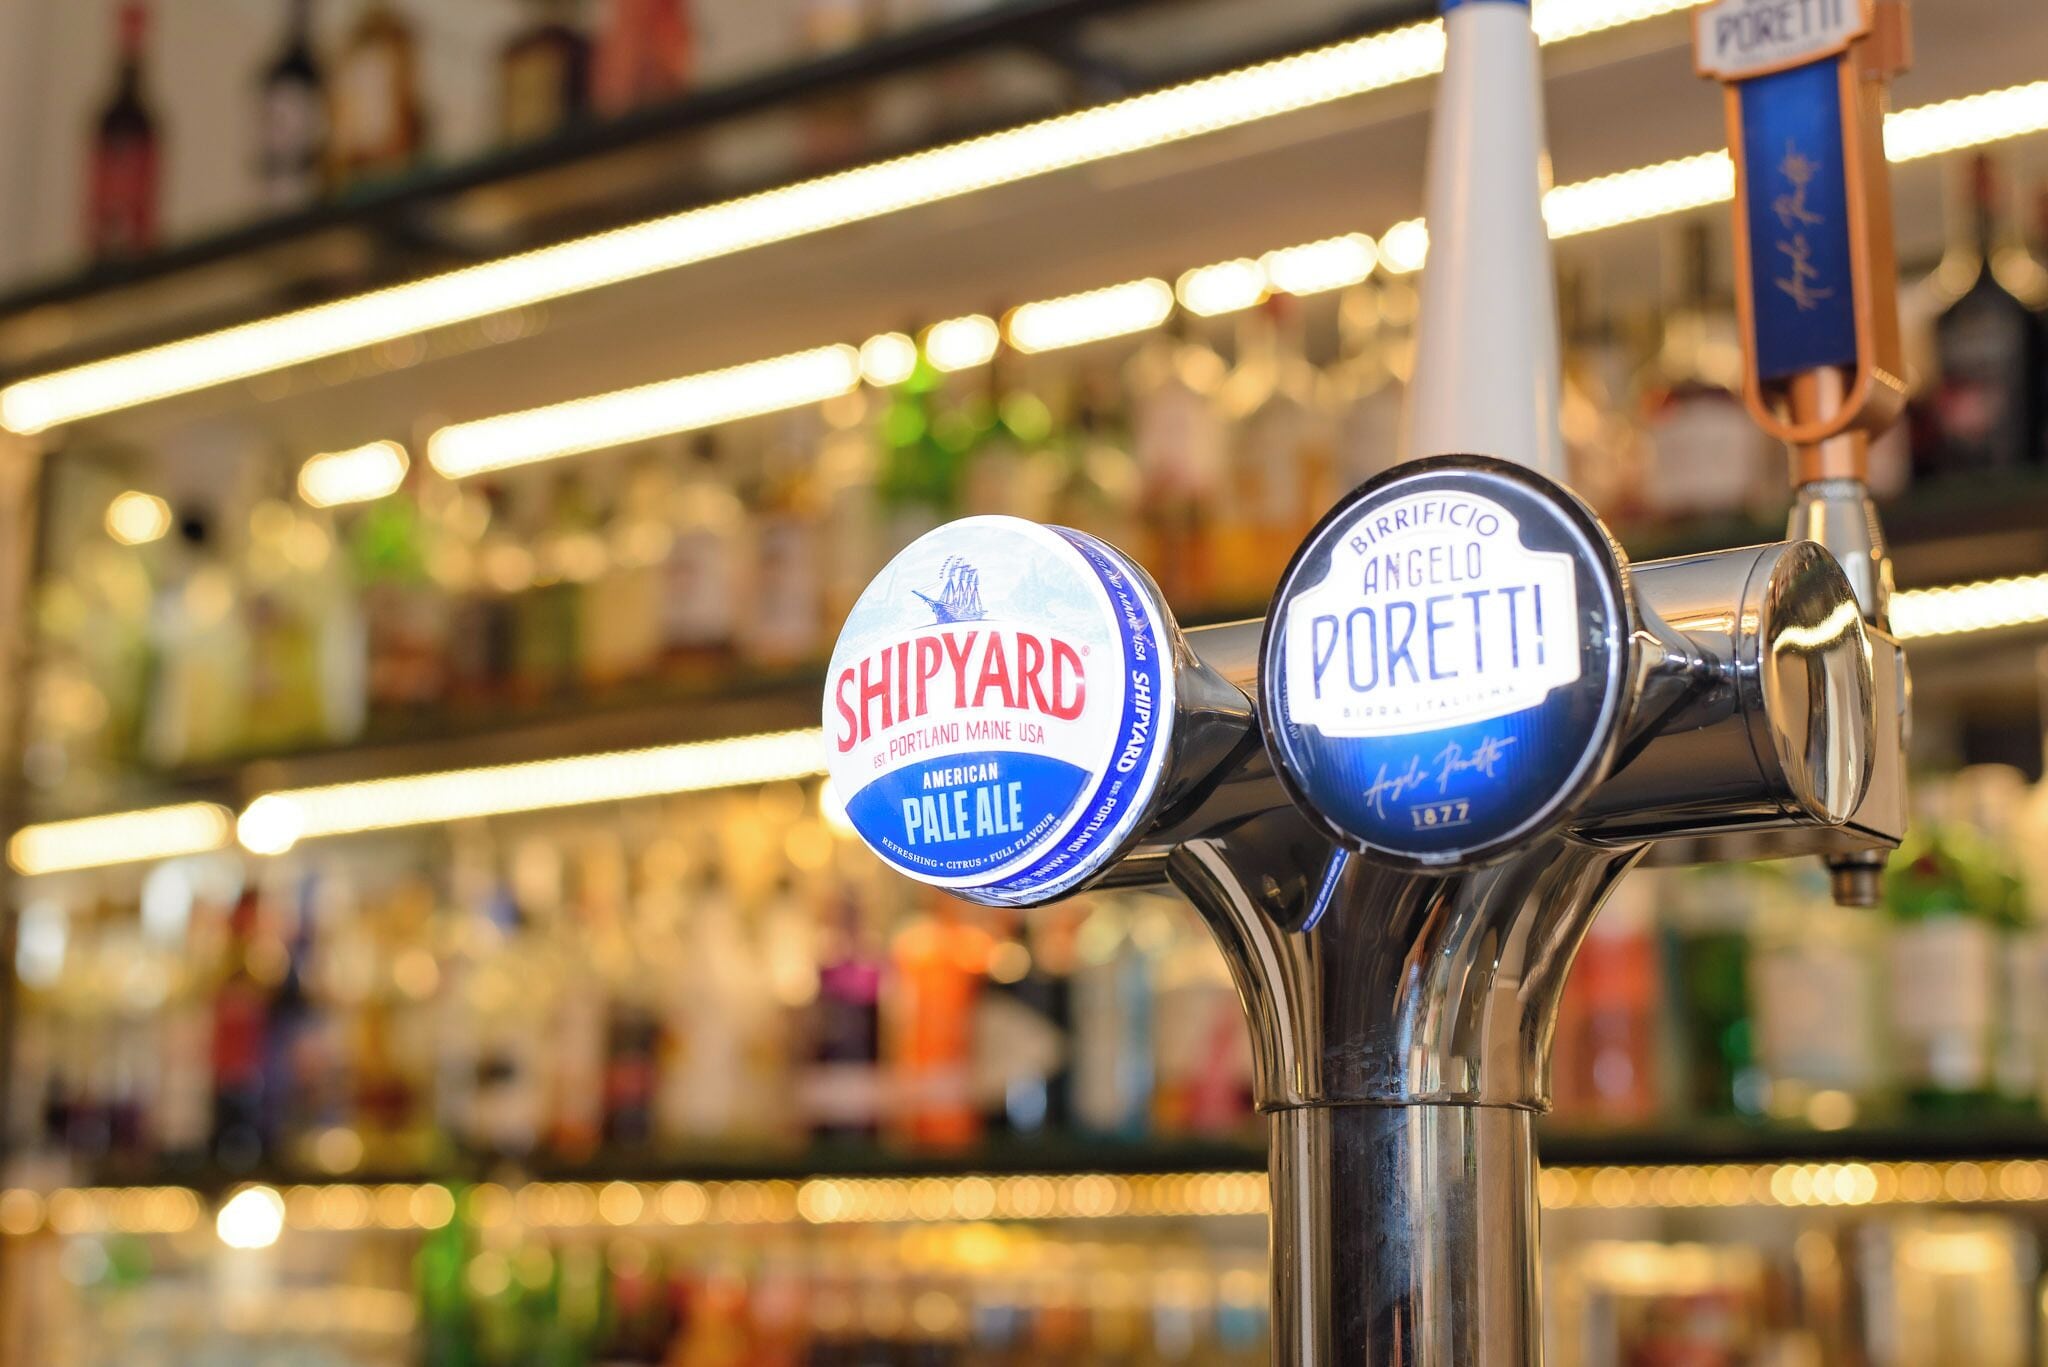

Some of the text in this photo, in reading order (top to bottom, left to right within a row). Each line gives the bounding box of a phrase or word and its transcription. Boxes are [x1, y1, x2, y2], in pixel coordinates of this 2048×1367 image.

[1351, 502, 1499, 556] BIRRIFICIO
[1363, 541, 1482, 595] ANGELO
[1133, 635, 1147, 661] USA
[1311, 584, 1545, 699] PORETTI
[835, 630, 1086, 753] SHIPYARD
[1343, 706, 1401, 718] BIRRA
[889, 723, 959, 760] PORTLAND
[966, 720, 1012, 742] MAINE
[1019, 723, 1045, 744] USA
[1116, 670, 1151, 774] SHIPYARD
[923, 762, 998, 790] AMERICAN
[902, 781, 1024, 845] PALE ALE
[1067, 797, 1117, 852] PORTLAND
[1412, 802, 1470, 827] 1877
[881, 812, 1056, 869] REFRESHING CITRUS FULL FLAVOUR
